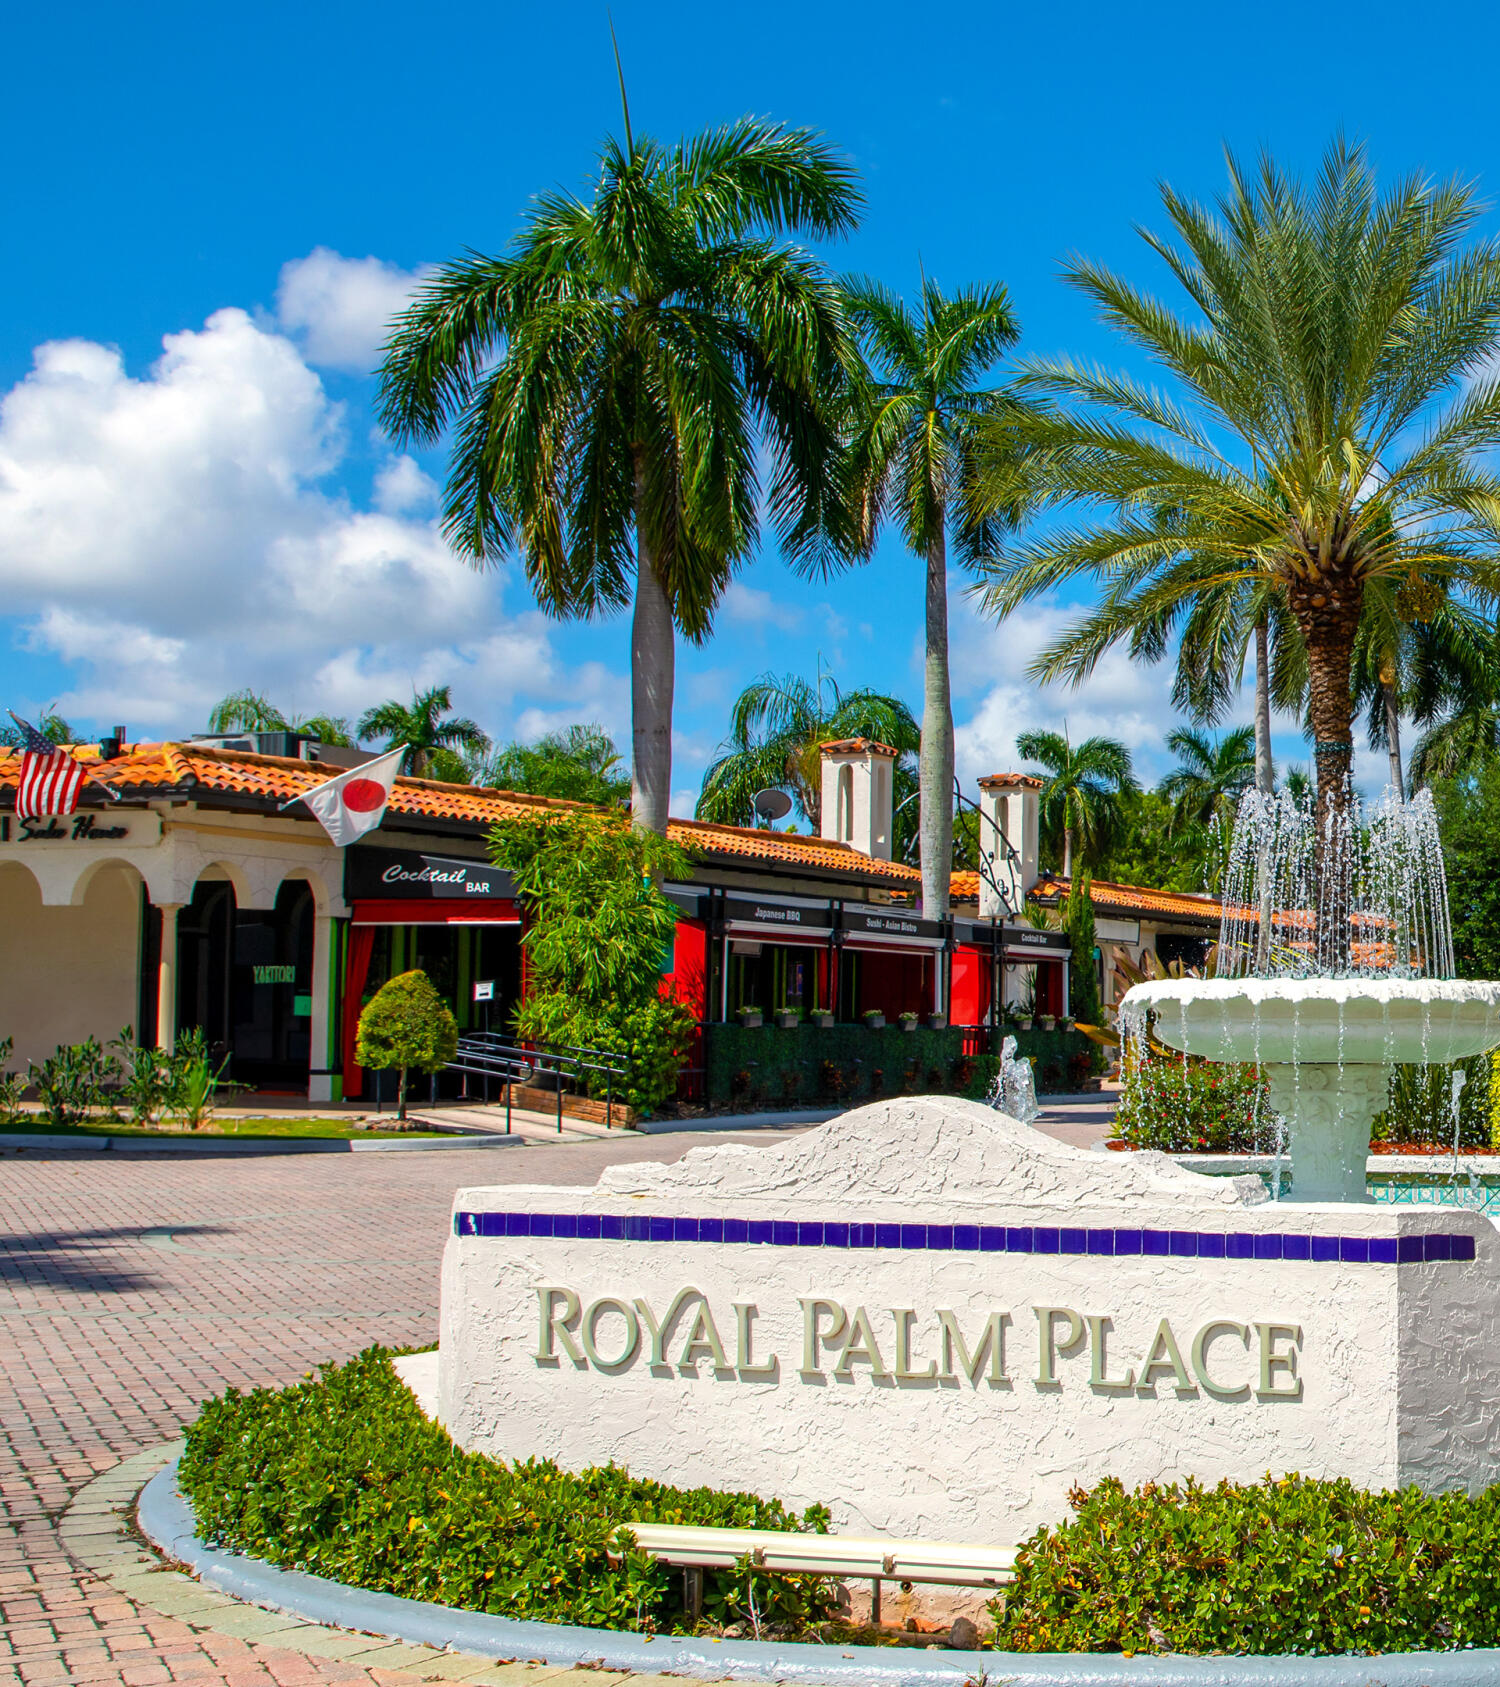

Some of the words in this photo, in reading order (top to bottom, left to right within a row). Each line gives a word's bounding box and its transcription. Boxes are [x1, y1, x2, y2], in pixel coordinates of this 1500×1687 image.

[382, 865, 467, 883] Cocktail
[465, 882, 490, 893] BAR
[755, 907, 786, 920] Japanese
[786, 910, 800, 921] BBQ
[866, 918, 882, 928] Sushi
[885, 919, 900, 930] Asian
[901, 921, 917, 933] Bistro
[532, 1285, 779, 1374] ROYAL
[796, 1297, 1011, 1385] PALM
[1032, 1306, 1303, 1397] PLACE
